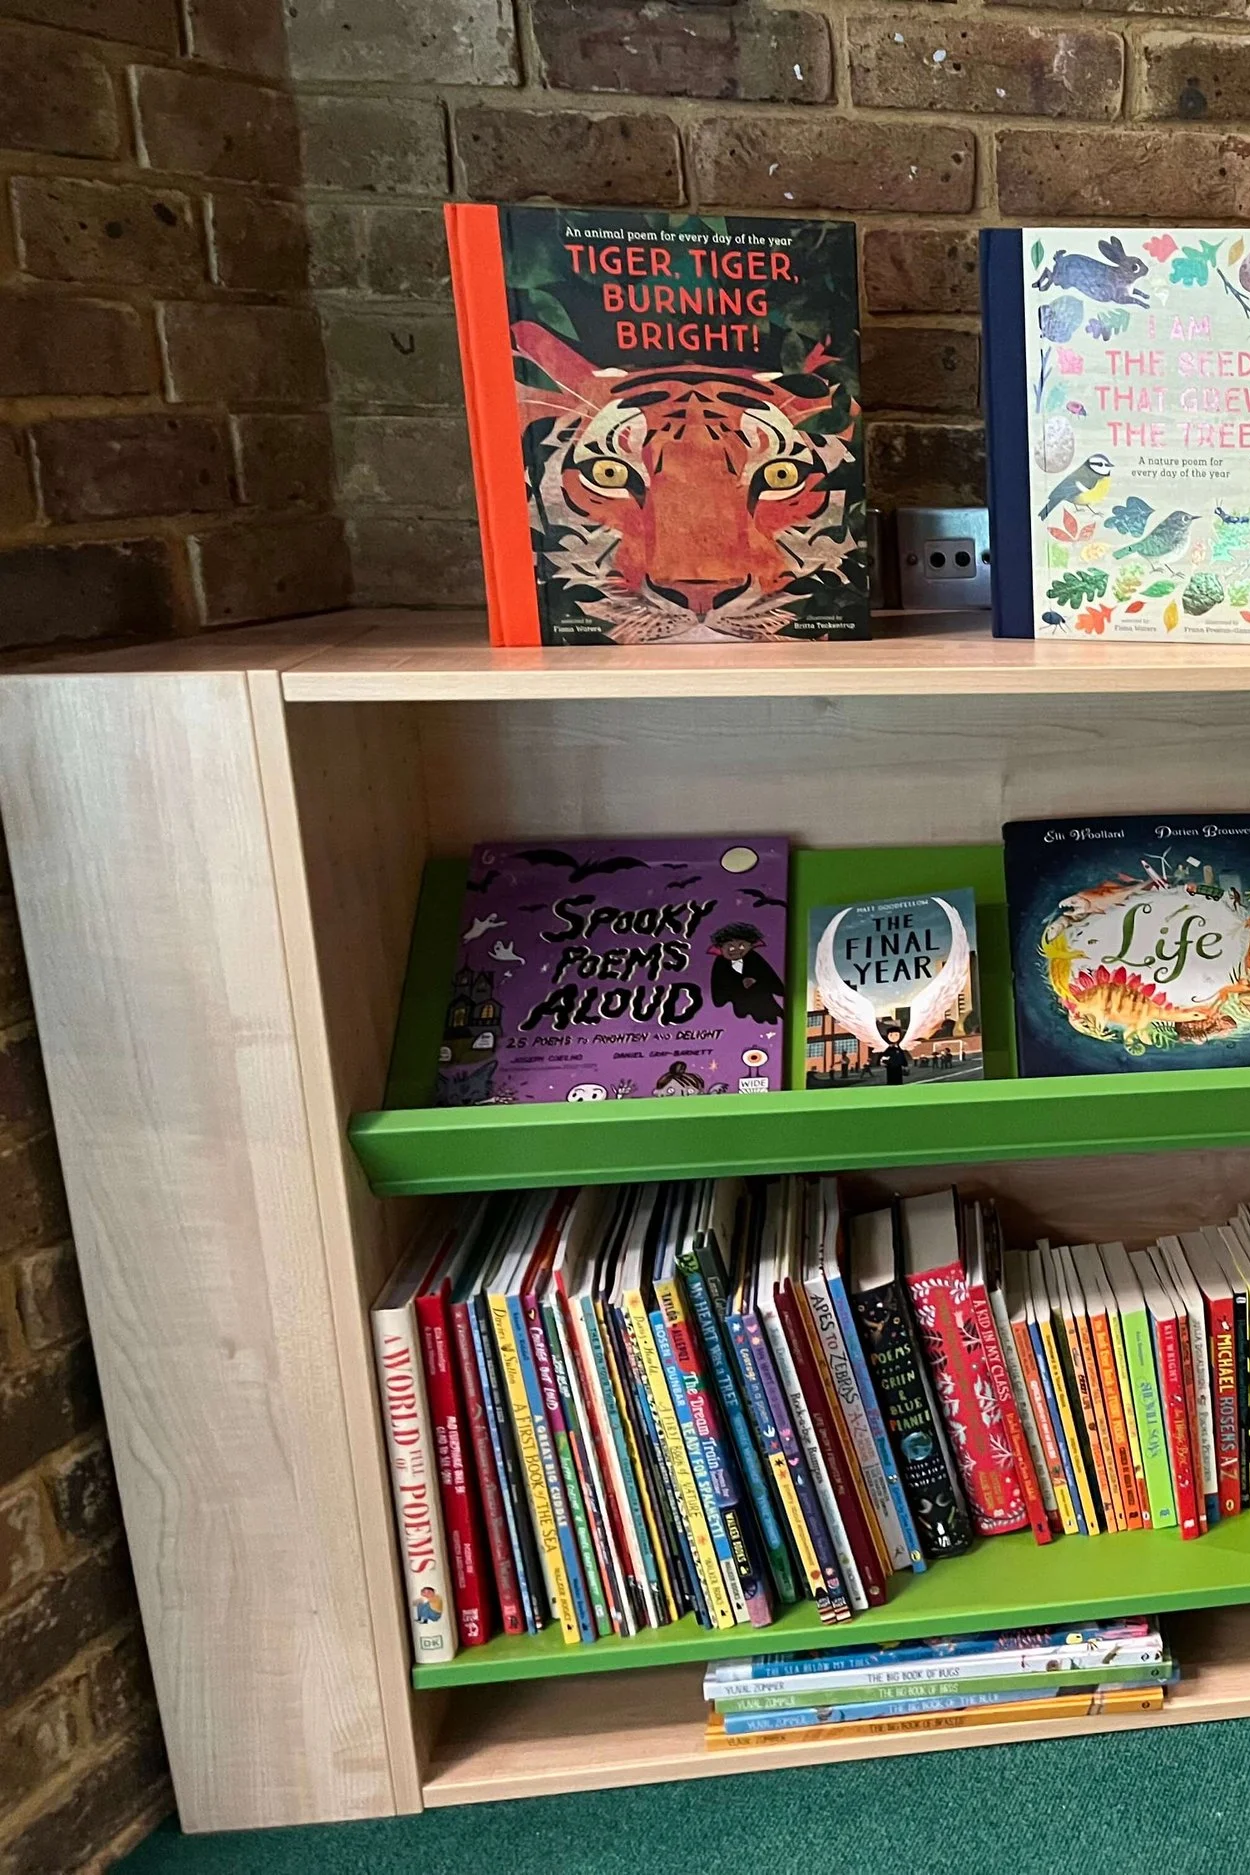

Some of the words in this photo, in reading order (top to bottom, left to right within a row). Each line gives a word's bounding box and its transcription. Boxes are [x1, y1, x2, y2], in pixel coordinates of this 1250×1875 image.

[566, 227, 581, 237] An
[584, 228, 624, 239] animal
[627, 231, 657, 241] poem
[661, 230, 676, 241] for
[679, 234, 708, 244] every
[713, 234, 731, 245] day
[735, 234, 746, 244] of
[748, 235, 765, 244] the
[768, 237, 792, 247] year
[564, 244, 680, 279] TIGER,
[689, 249, 799, 283] TIGER,
[603, 283, 767, 316] BURNING
[616, 321, 760, 352] BRIGHT!
[1148, 316, 1156, 339] I
[1169, 316, 1213, 340] AM
[1105, 350, 1165, 376] THE
[1095, 385, 1166, 413] THAT
[1107, 422, 1166, 448] THE
[1139, 457, 1145, 465] A
[1182, 459, 1207, 468] poem
[1210, 458, 1223, 466] for
[1160, 468, 1175, 478] day
[1180, 469, 1188, 477] of
[1192, 469, 1206, 477] the
[1154, 825, 1199, 839] Dorien
[872, 914, 914, 932] THE
[846, 929, 940, 961] FINAL
[1101, 902, 1223, 984] Life
[551, 940, 691, 985] POEMS
[853, 956, 933, 985] YEAR
[518, 982, 703, 1032] ALOUD
[506, 1037, 527, 1049] 25
[532, 1035, 571, 1047] POEMS
[593, 1032, 648, 1045] FRIGHTEN
[676, 1029, 724, 1040] DELIGHT
[740, 1079, 767, 1088] WIDE
[688, 1280, 706, 1302] My
[972, 1297, 986, 1309] A
[491, 1305, 512, 1340] Davies
[694, 1299, 719, 1344] HEART
[809, 1291, 836, 1333] APES
[976, 1308, 992, 1329] KID
[382, 1333, 402, 1344] A
[824, 1332, 840, 1350] TO
[981, 1329, 995, 1343] IN
[1163, 1324, 1172, 1339] KIT
[652, 1322, 671, 1358] ROSEN
[664, 1364, 686, 1407] DUNBAR
[707, 1343, 725, 1367] Was
[870, 1343, 911, 1365] POEMS
[985, 1343, 1001, 1364] MY
[1165, 1343, 1177, 1383] WRIGHT
[1217, 1334, 1233, 1392] MICHAEL
[681, 1370, 701, 1396] The
[827, 1349, 859, 1406] ZEBRAS
[990, 1363, 1011, 1402] CLASS
[380, 1347, 421, 1447] WORLD
[542, 1385, 560, 1411] LOUD
[717, 1375, 738, 1408] TREE
[512, 1401, 527, 1412] A
[533, 1412, 545, 1423] A
[689, 1396, 713, 1437] Dream
[515, 1415, 537, 1452] FIRST
[535, 1423, 553, 1460] GREAT
[679, 1420, 700, 1453] READY
[394, 1457, 407, 1470] OF
[408, 1449, 425, 1477] FULL
[700, 1436, 722, 1470] Train
[524, 1452, 545, 1490] BOOK
[543, 1461, 558, 1484] BIG
[690, 1456, 708, 1478] FOR
[535, 1501, 554, 1528] THE
[548, 1484, 568, 1528] CUDDLE
[697, 1479, 727, 1539] SPAGHETTI
[397, 1481, 438, 1574] POEMS
[724, 1511, 741, 1540] WALKER
[540, 1527, 558, 1553] SEA
[732, 1539, 747, 1563] BOOKS
